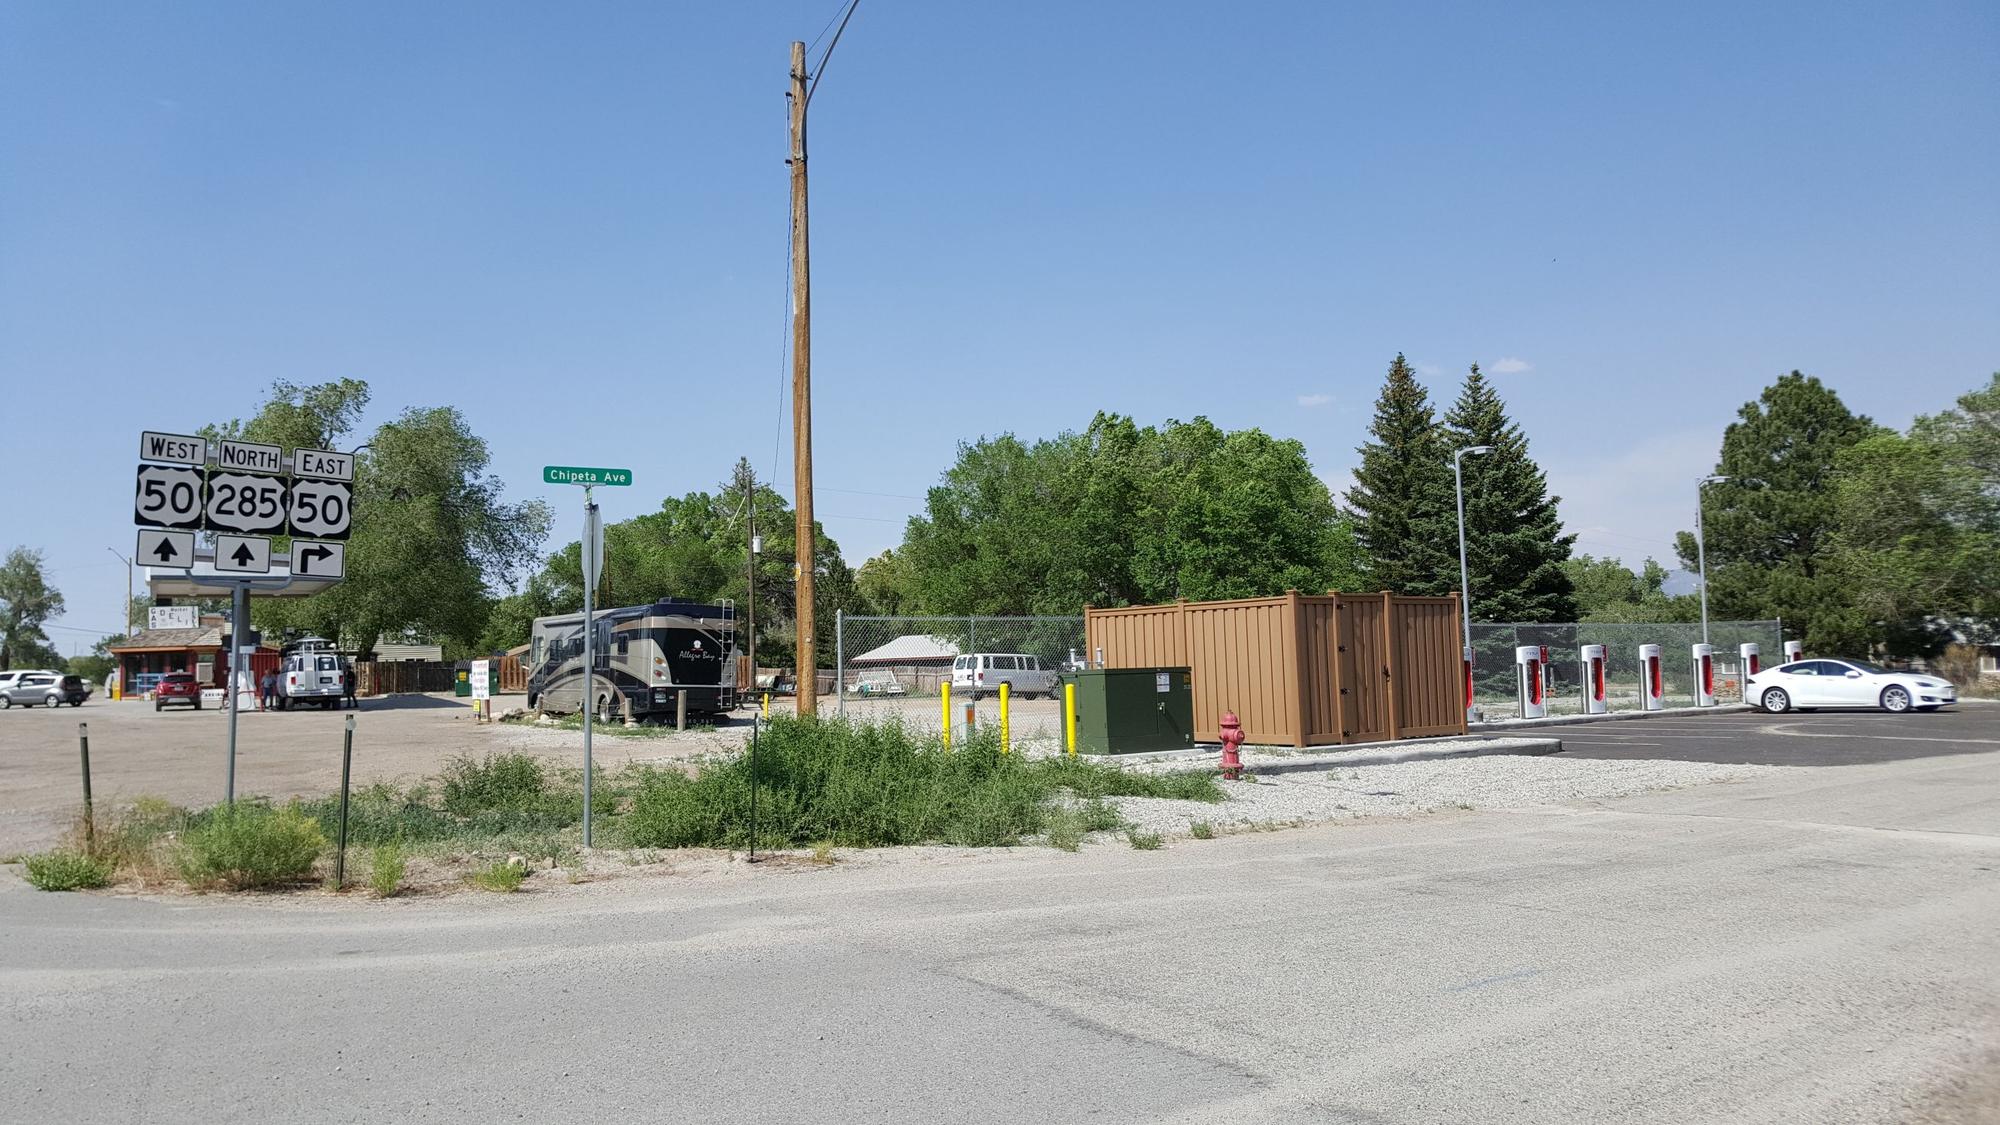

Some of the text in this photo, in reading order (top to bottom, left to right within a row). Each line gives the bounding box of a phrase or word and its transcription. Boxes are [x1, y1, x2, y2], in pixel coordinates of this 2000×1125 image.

[151, 437, 199, 460] WEST
[223, 445, 278, 469] NORTH
[303, 454, 346, 476] EAST
[550, 469, 626, 483] Chipeta Ave
[144, 480, 194, 514] 50
[215, 484, 277, 518] 285
[297, 493, 343, 526] 50
[679, 650, 715, 661] Allegro Bay
